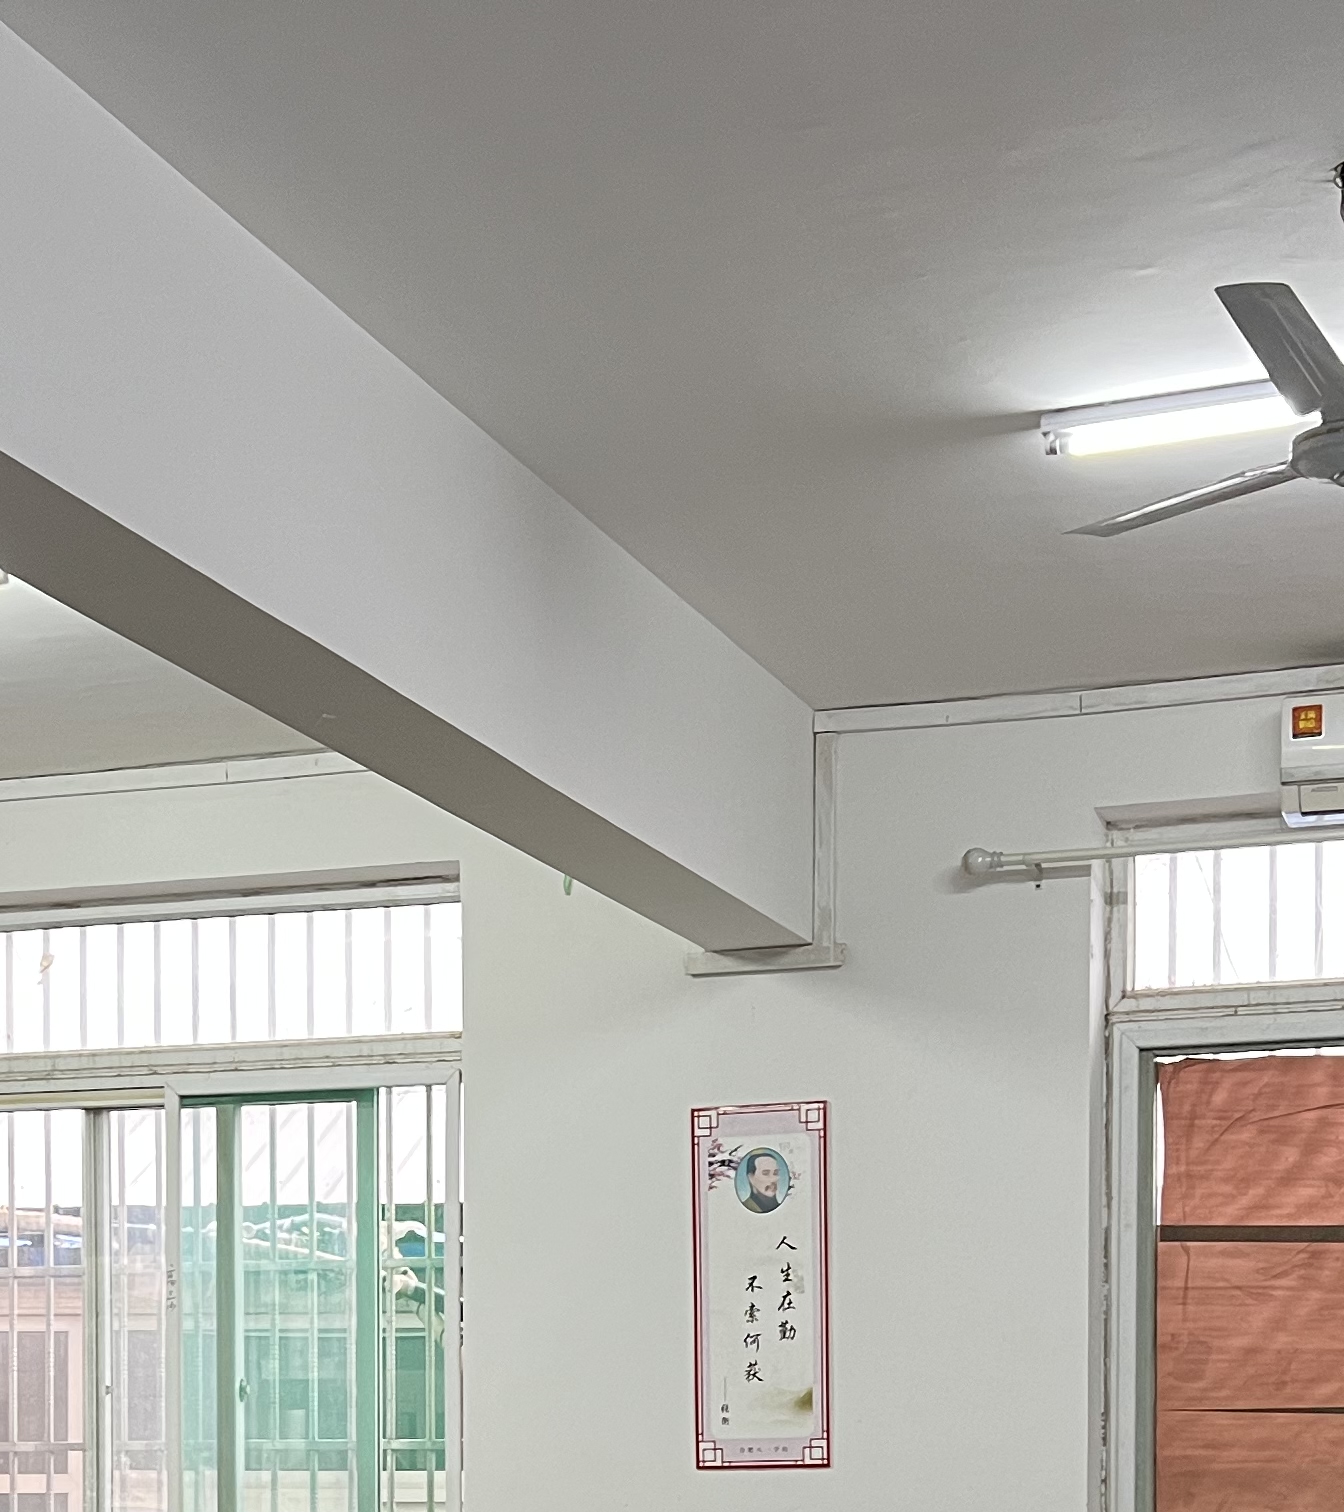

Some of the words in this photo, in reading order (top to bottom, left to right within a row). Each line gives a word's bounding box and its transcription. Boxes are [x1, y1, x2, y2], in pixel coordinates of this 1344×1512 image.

[744, 1275, 764, 1383] 不索何获
[775, 1236, 797, 1341] 人生在勤
